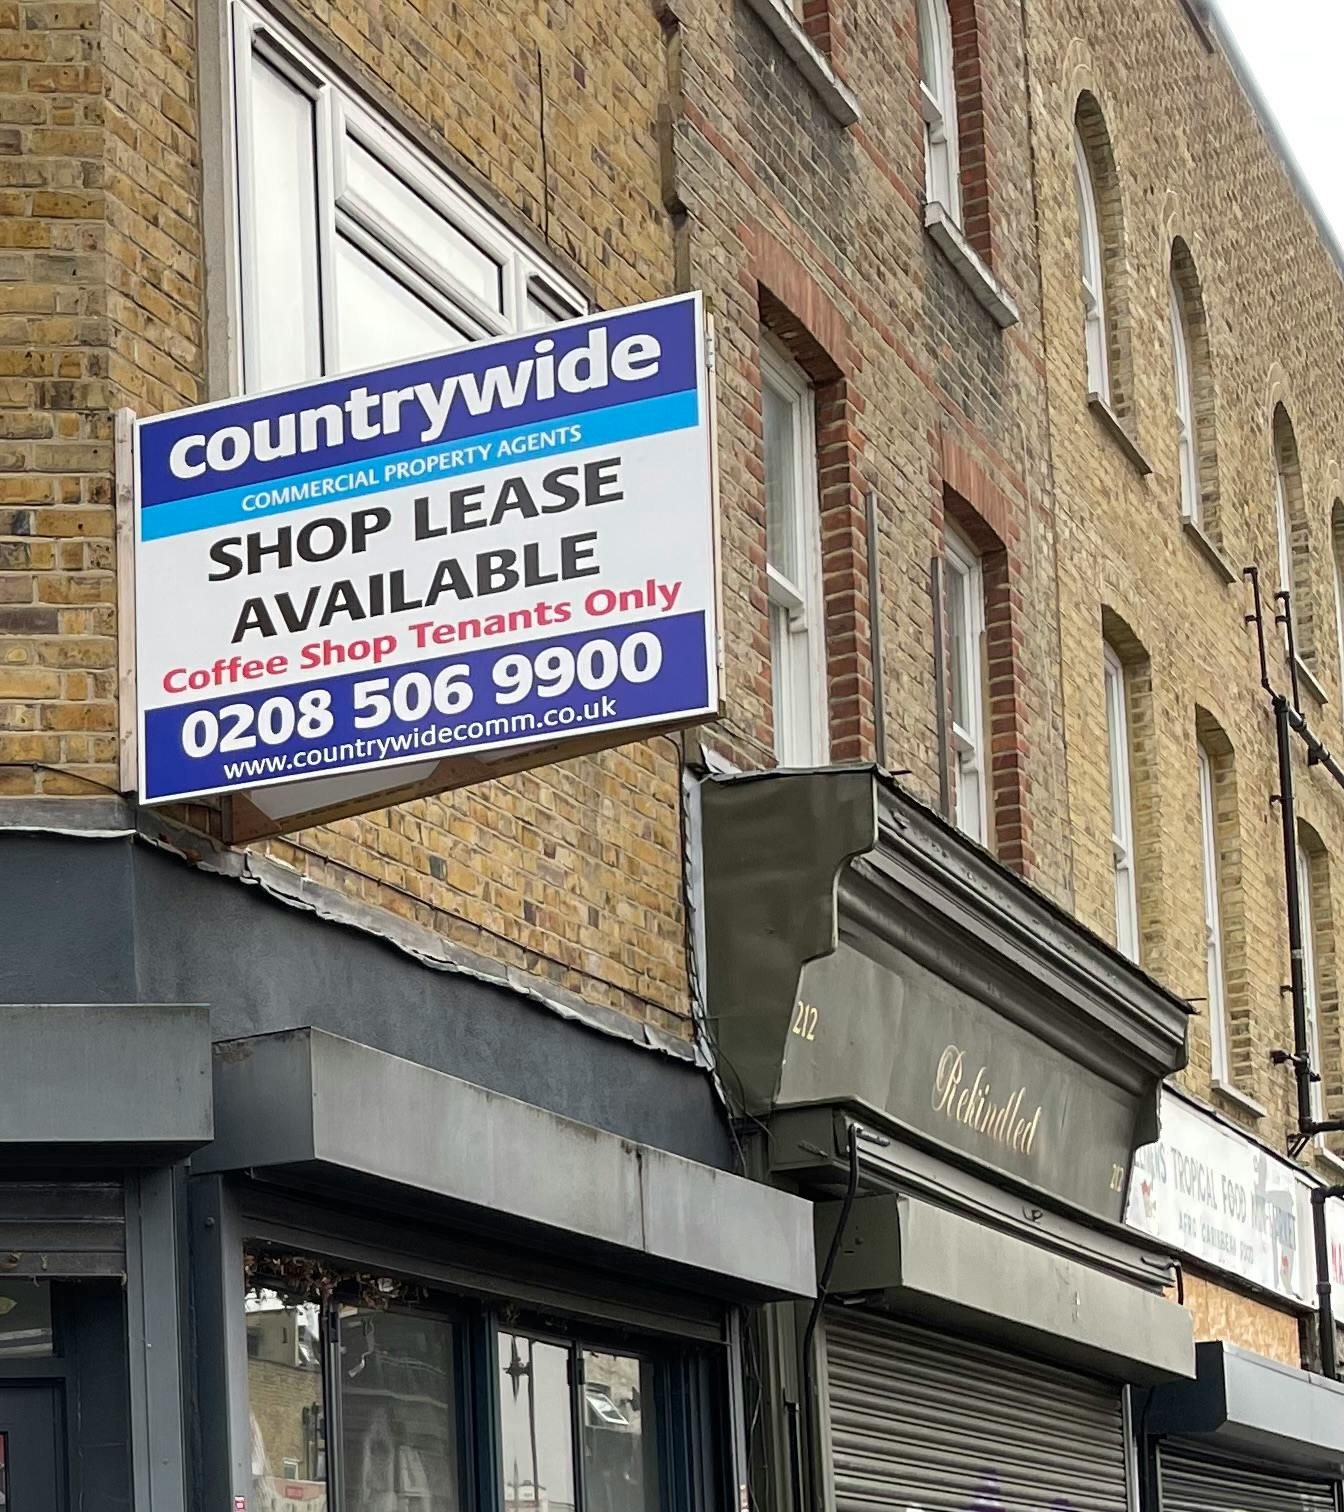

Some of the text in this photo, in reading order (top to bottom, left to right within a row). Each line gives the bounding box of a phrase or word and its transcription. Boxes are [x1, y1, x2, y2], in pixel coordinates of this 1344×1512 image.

[169, 327, 662, 479] countrywide
[208, 457, 625, 582] SHOP LEASE
[242, 425, 582, 512] COMMERCIAL PROPERTY AGENTS
[163, 579, 682, 694] Coffee Shop Tenants Only
[231, 532, 600, 644] AVAILABLE
[181, 631, 663, 759] 0208 506 9900
[224, 697, 616, 780] www.countrywidecomm.co.uk
[792, 1001, 818, 1041] 212
[932, 1045, 1042, 1155] Rekindled
[1171, 1148, 1218, 1210] TROPICAL
[1221, 1175, 1247, 1223] FOOD
